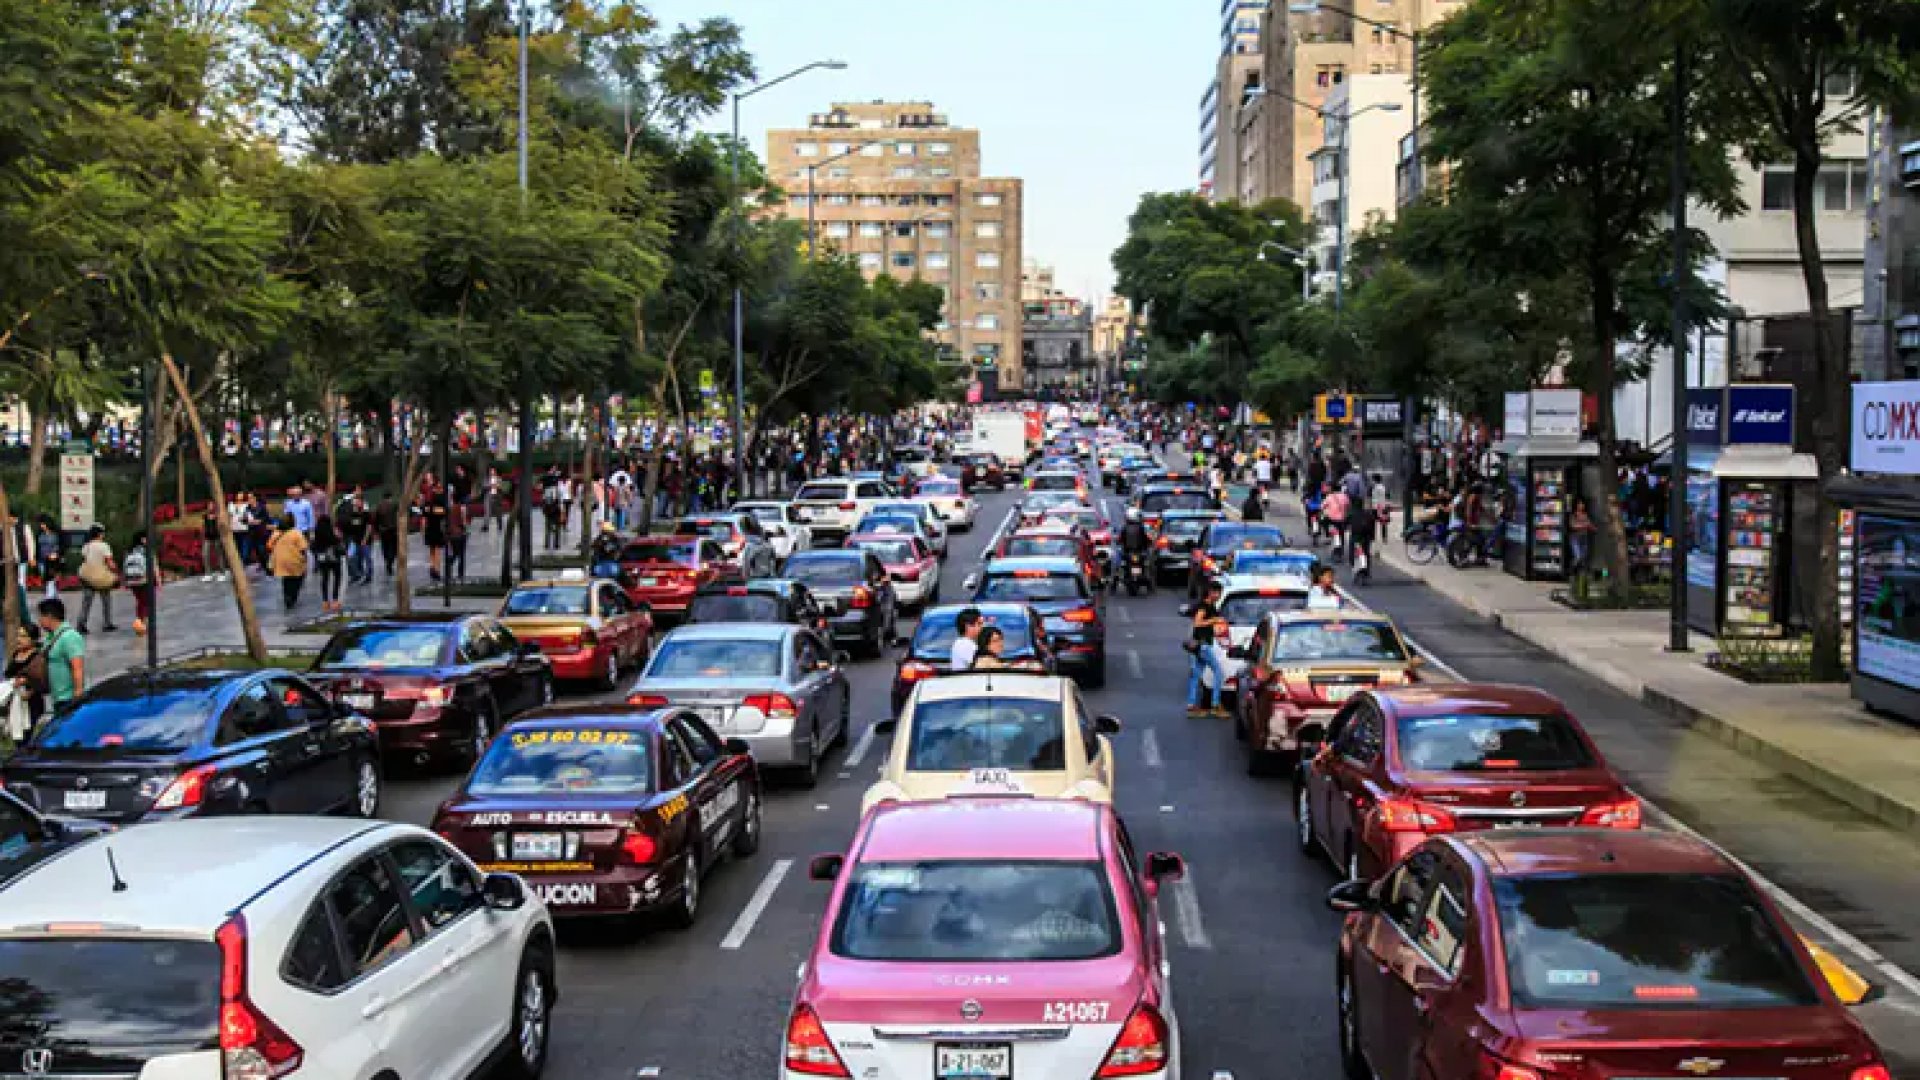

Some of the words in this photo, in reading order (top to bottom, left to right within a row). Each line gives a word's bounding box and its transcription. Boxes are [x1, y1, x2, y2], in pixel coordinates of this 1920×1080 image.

[1863, 401, 1920, 441] CDMX
[471, 812, 513, 825] AUTO
[546, 810, 613, 825] ESCUELA
